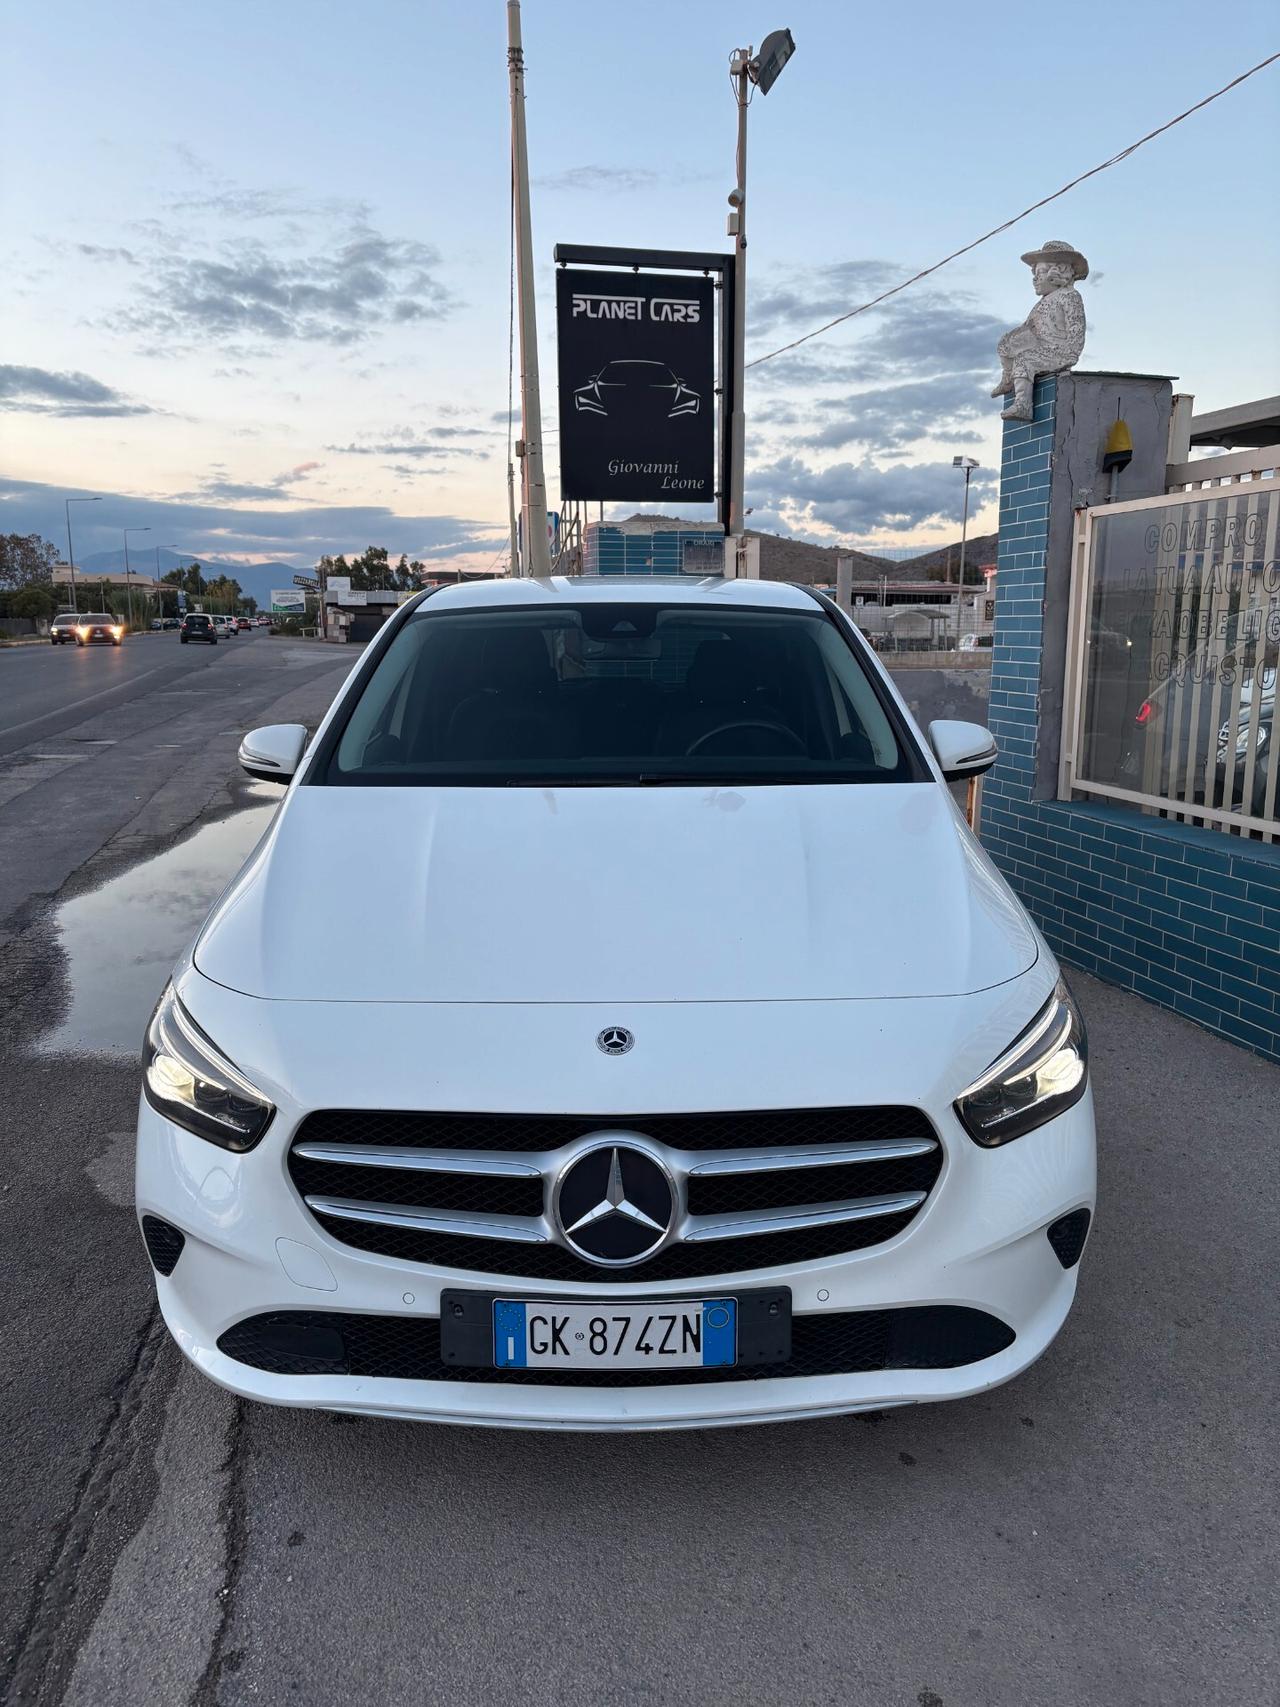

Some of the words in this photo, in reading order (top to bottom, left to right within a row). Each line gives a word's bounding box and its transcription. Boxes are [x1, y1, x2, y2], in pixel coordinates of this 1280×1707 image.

[572, 293, 646, 320] PLANET
[650, 298, 700, 322] CARS
[608, 459, 680, 476] Giovanni
[661, 476, 705, 489] Leone
[1144, 513, 1263, 554] COMPRO
[1203, 560, 1280, 594] AUTO
[1146, 651, 1277, 690] CQUISTO
[529, 1315, 570, 1355] GK
[589, 1314, 702, 1355] 874ZN
